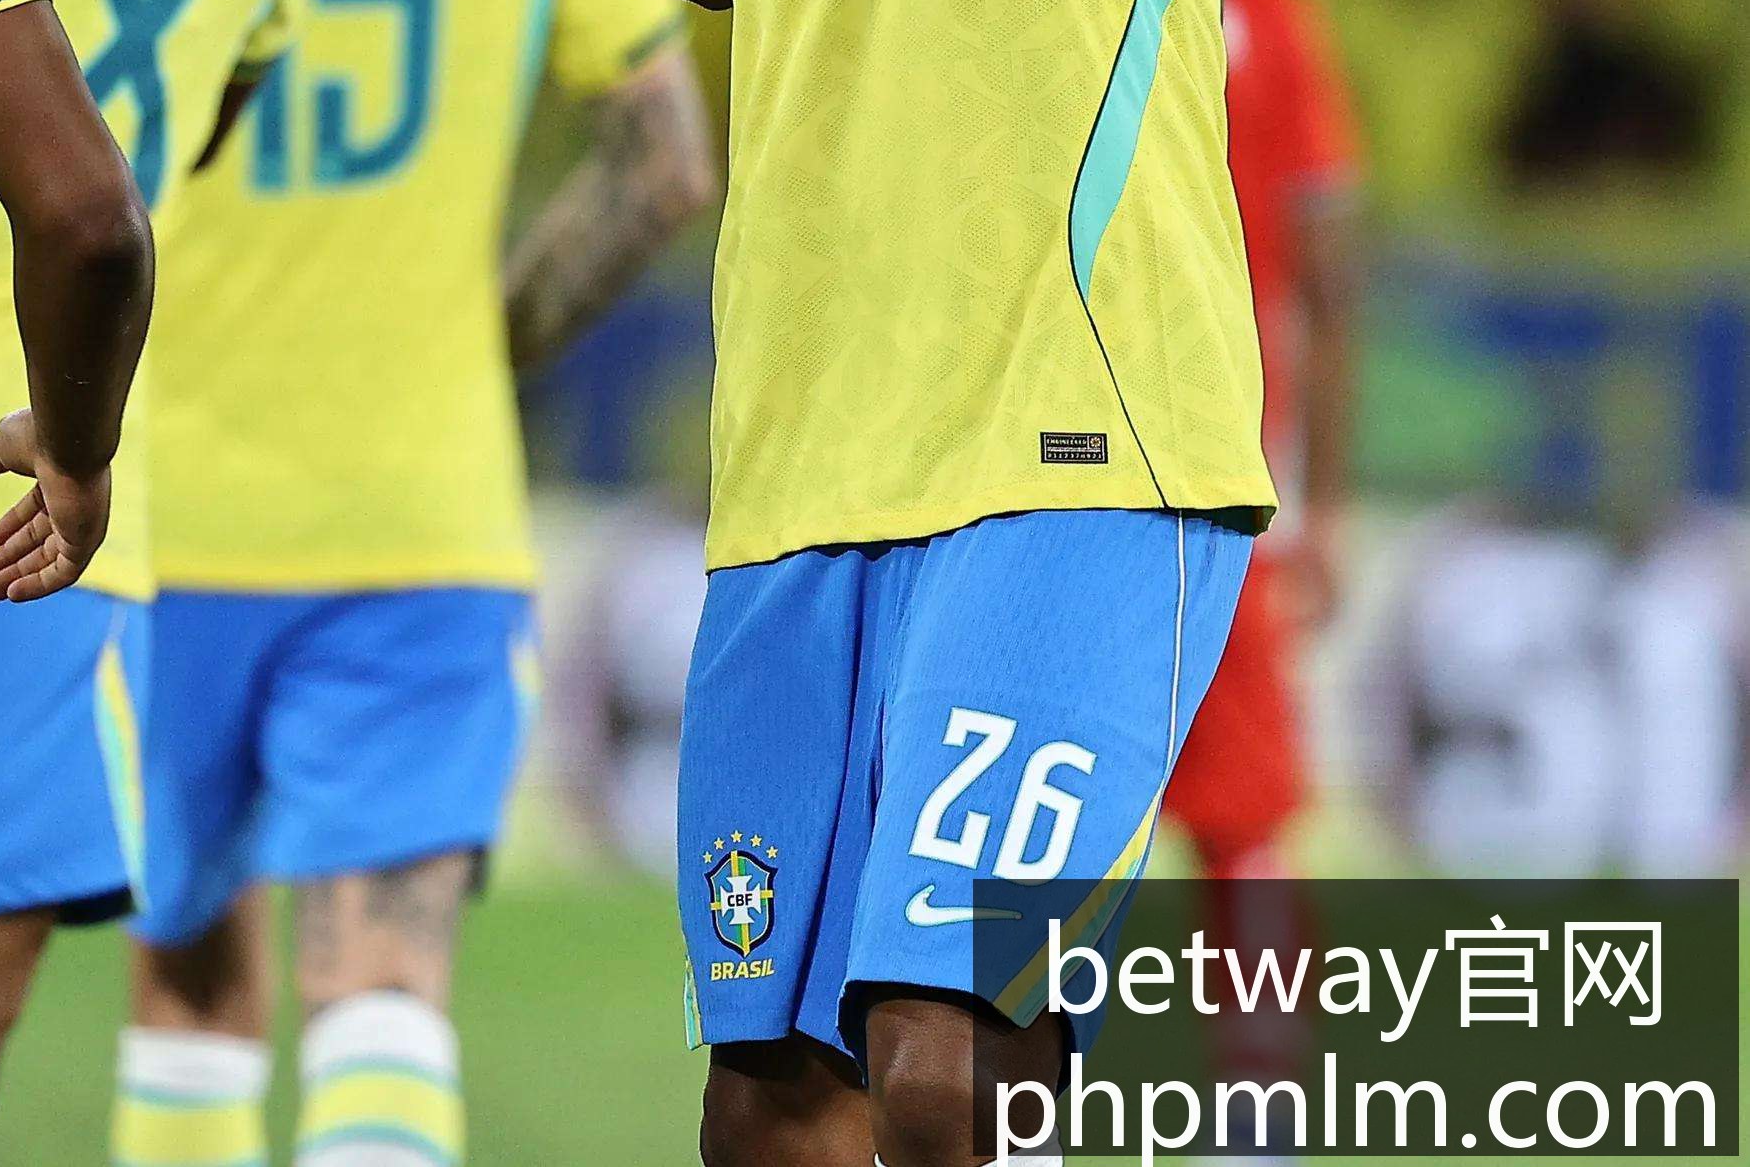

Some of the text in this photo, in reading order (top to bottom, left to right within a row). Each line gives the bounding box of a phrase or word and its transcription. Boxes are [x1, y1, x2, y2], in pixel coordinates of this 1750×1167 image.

[907, 706, 1099, 888] 26
[727, 893, 753, 907] CBF
[711, 958, 775, 982] BRASIL
